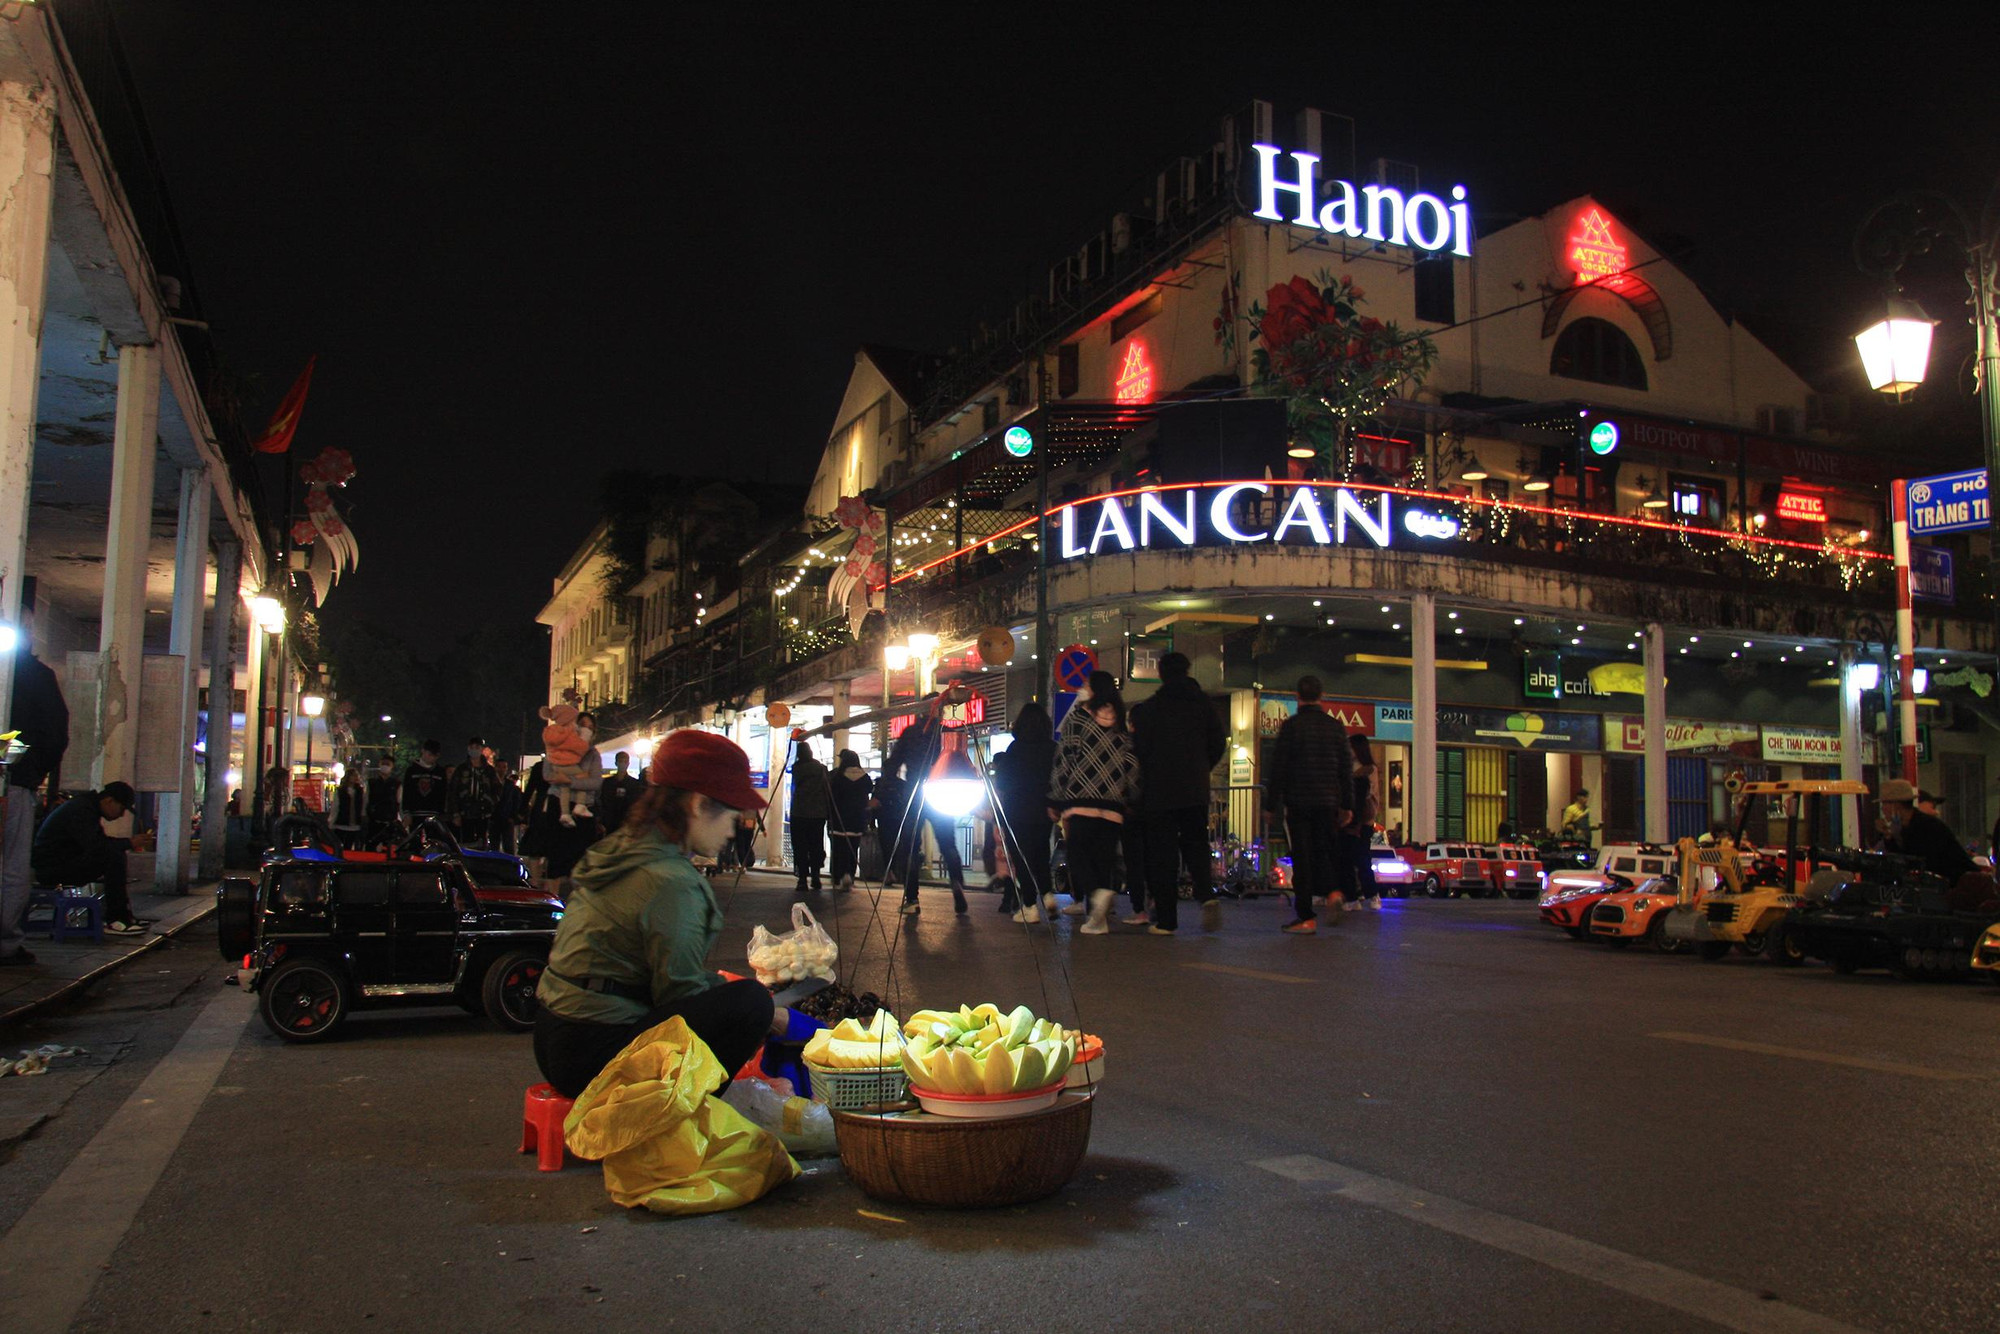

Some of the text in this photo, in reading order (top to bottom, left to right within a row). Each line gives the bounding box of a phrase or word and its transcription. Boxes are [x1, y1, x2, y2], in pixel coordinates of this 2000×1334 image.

[1252, 144, 1470, 257] Hanoi
[1573, 247, 1625, 269] ATTIC
[1633, 423, 1699, 449] HOTPOT
[1794, 448, 1840, 474] WINE
[1952, 474, 1987, 494] PHỐ
[1782, 495, 1822, 512] ATTIC
[1915, 498, 1990, 528] TRÀNG TI
[1063, 483, 1389, 558] LAN CAN
[1529, 666, 1557, 687] aha
[1664, 725, 1698, 741] offee
